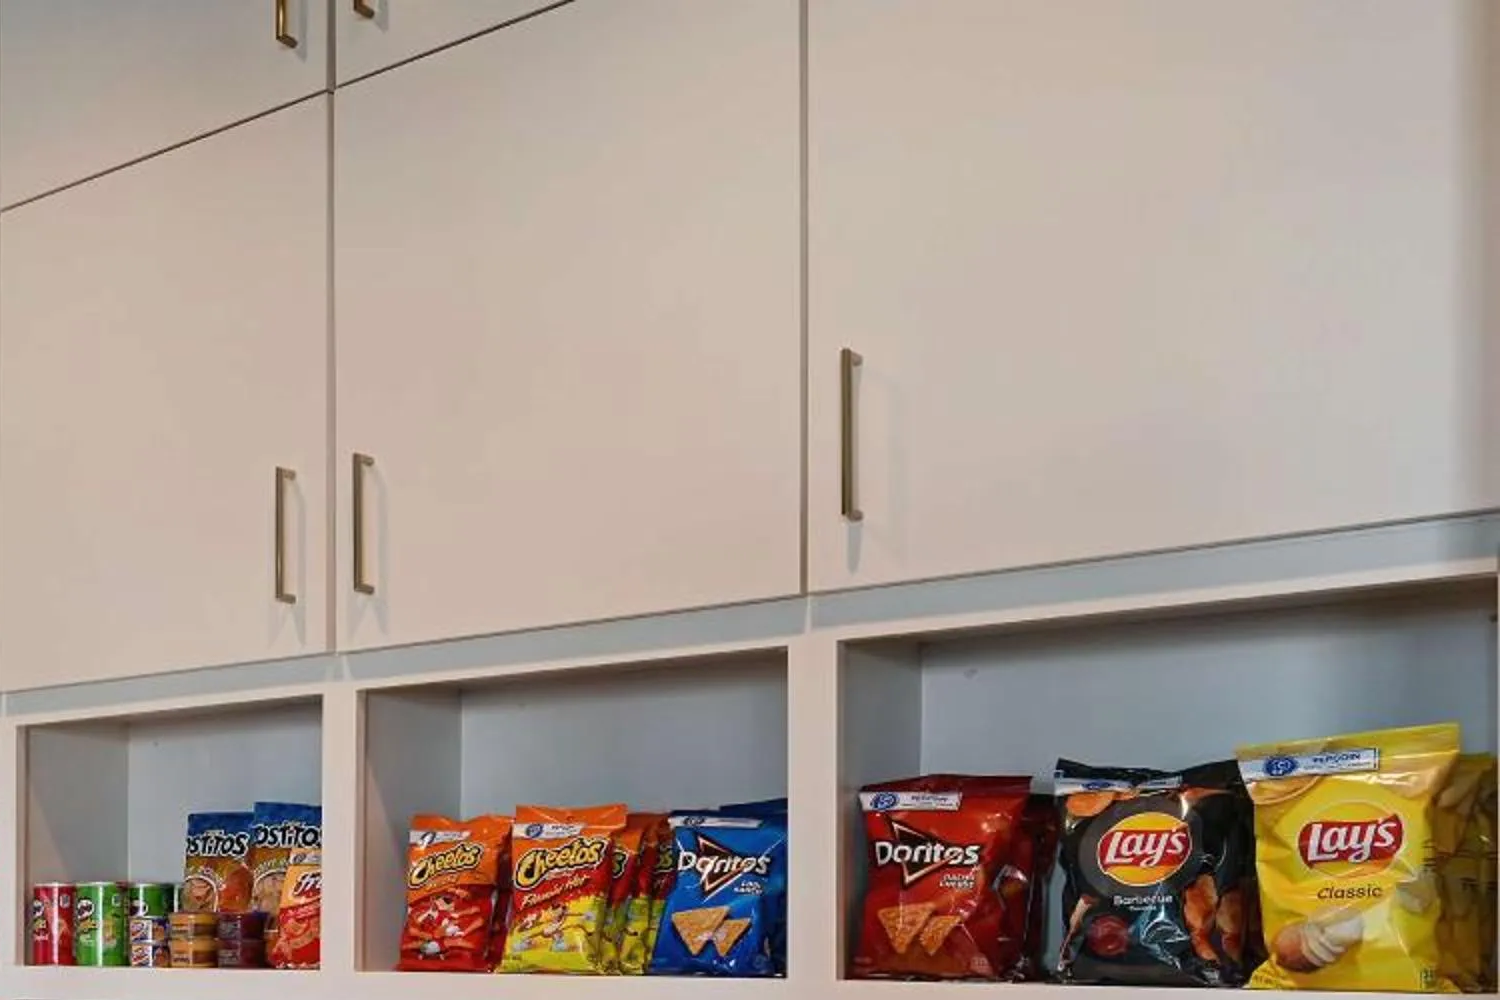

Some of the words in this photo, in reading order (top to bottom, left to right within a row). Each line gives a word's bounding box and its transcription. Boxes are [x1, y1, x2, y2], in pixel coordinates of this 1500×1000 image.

[875, 841, 980, 867] Doritos
[1103, 828, 1187, 868] Lay's
[1307, 817, 1397, 862] Lay's
[409, 844, 483, 887] Cheetos
[516, 837, 607, 888] Cheetos
[677, 850, 772, 876] Doritos
[1316, 883, 1383, 900] Classic
